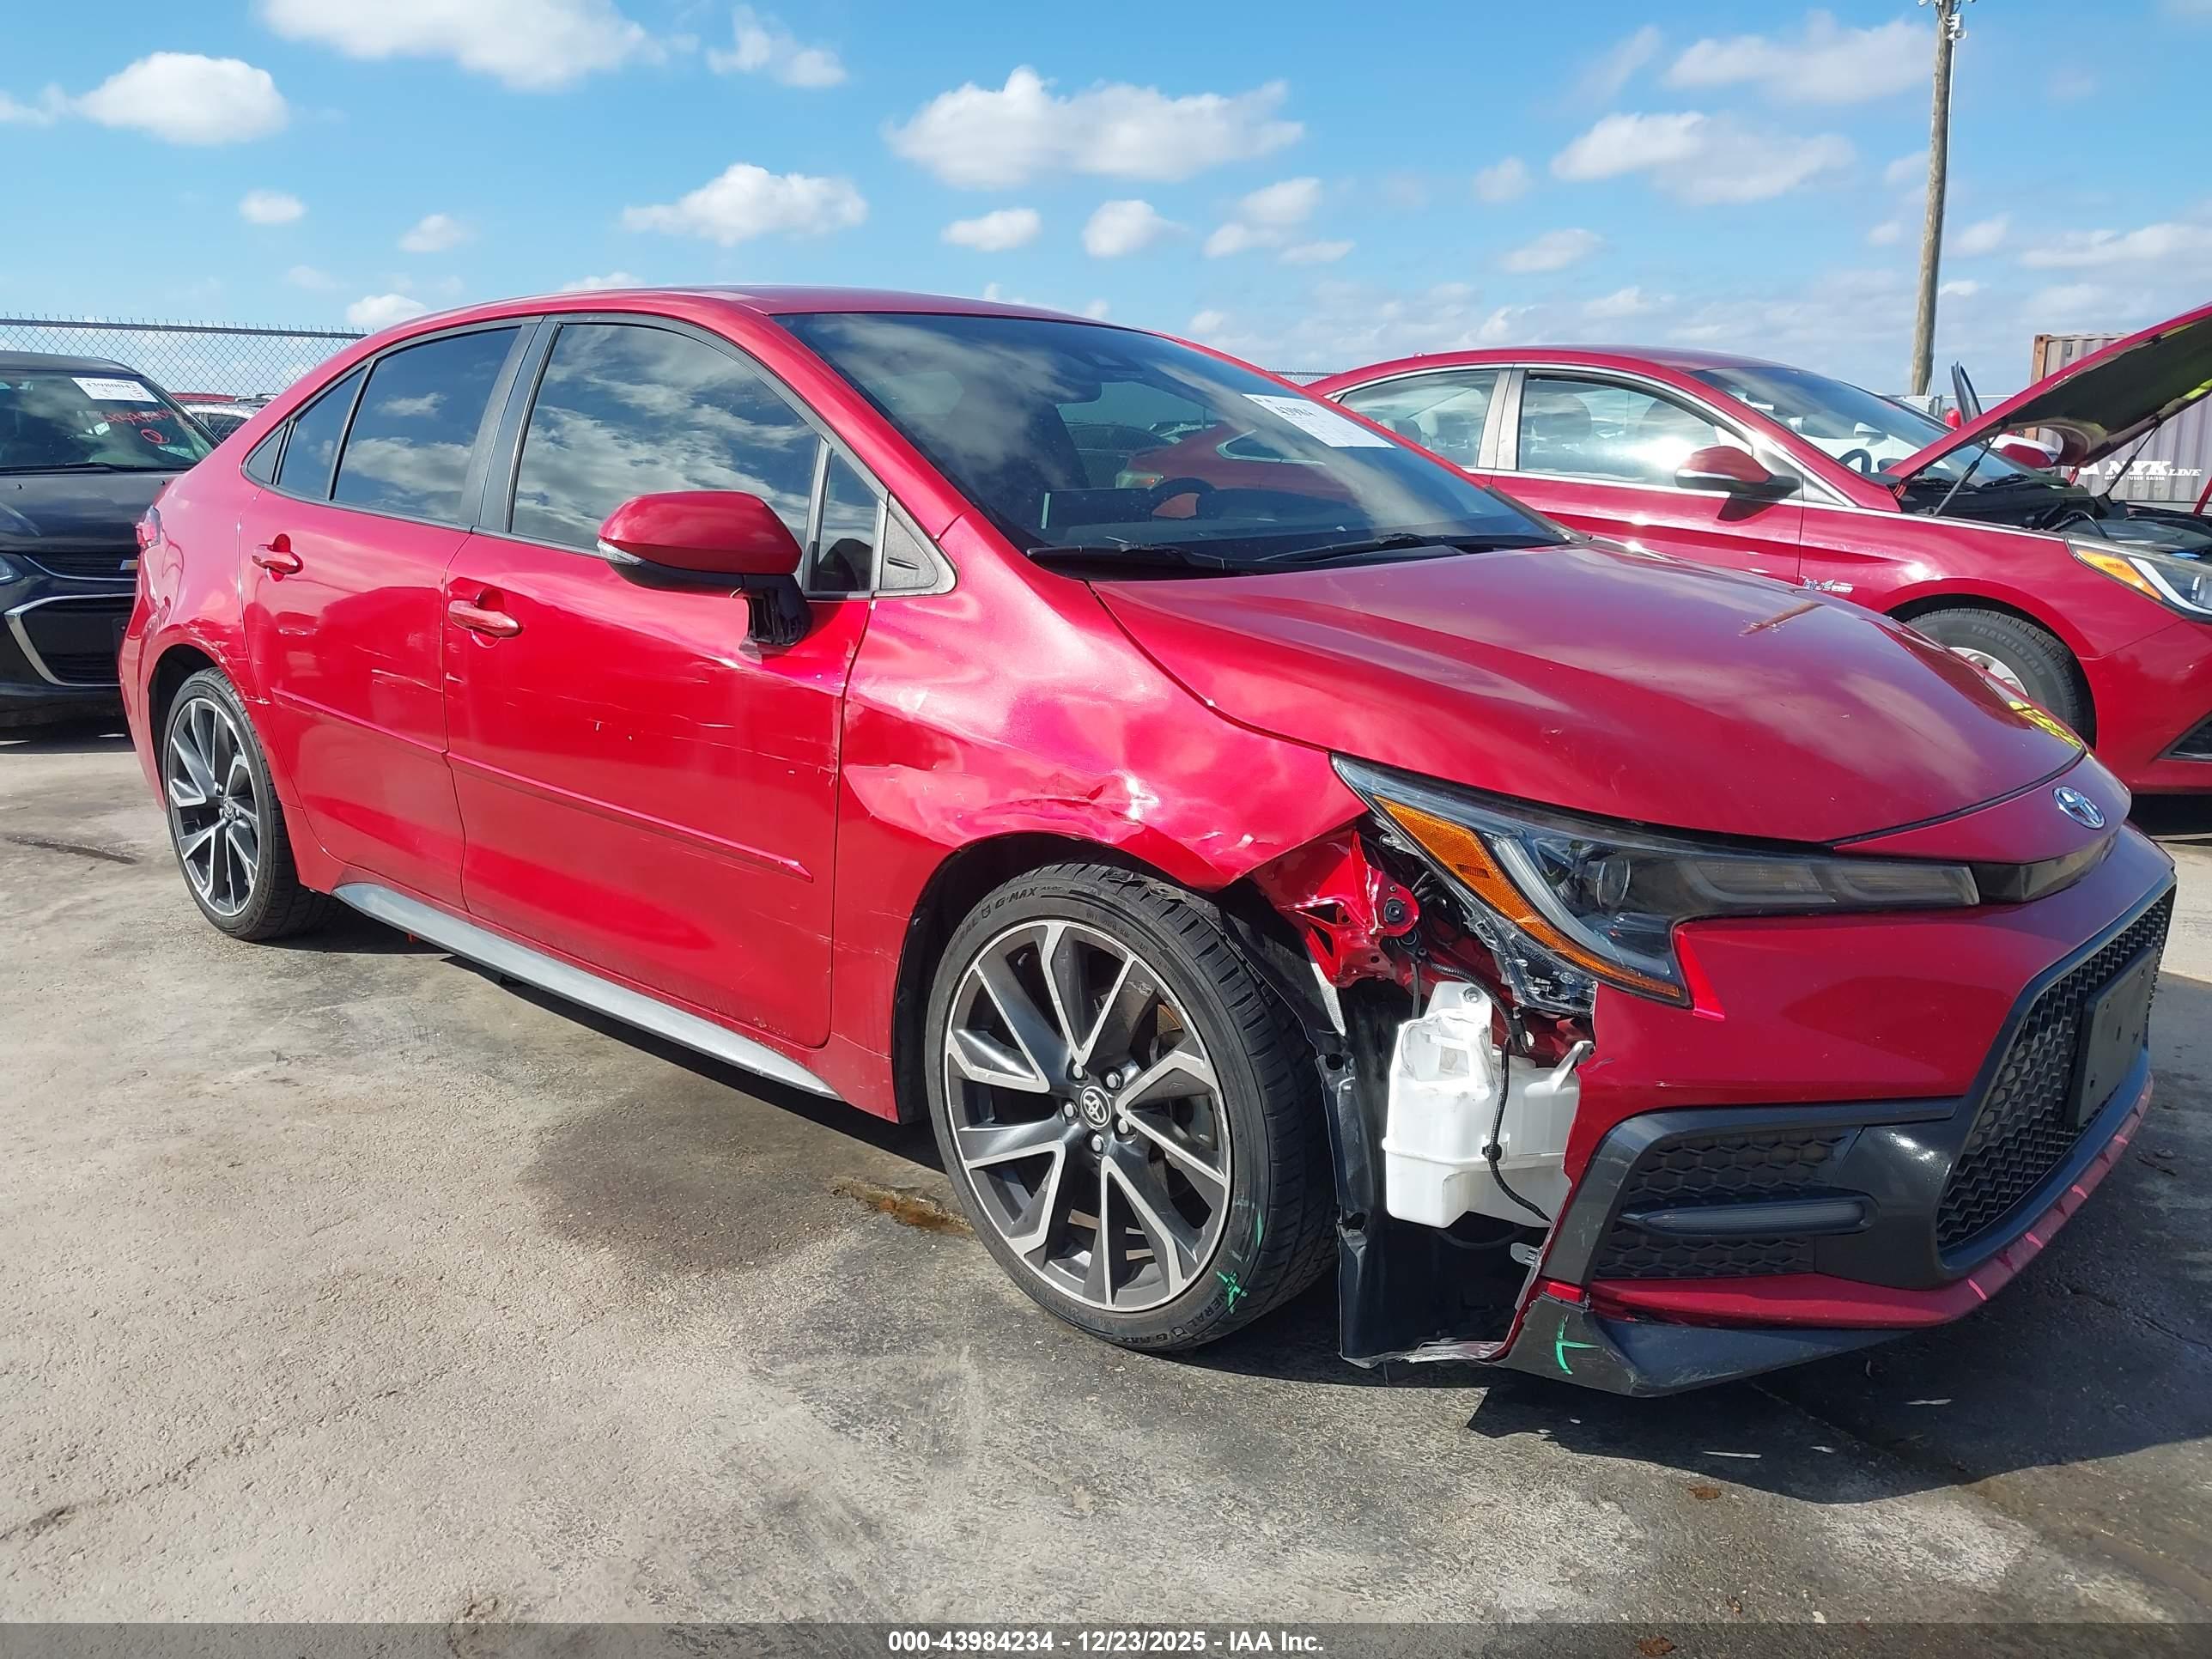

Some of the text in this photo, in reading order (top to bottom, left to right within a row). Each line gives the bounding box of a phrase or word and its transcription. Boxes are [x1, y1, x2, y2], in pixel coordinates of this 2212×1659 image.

[2105, 460, 2203, 477] NYK LINE
[1971, 623, 2045, 676] TRAVELSTAR
